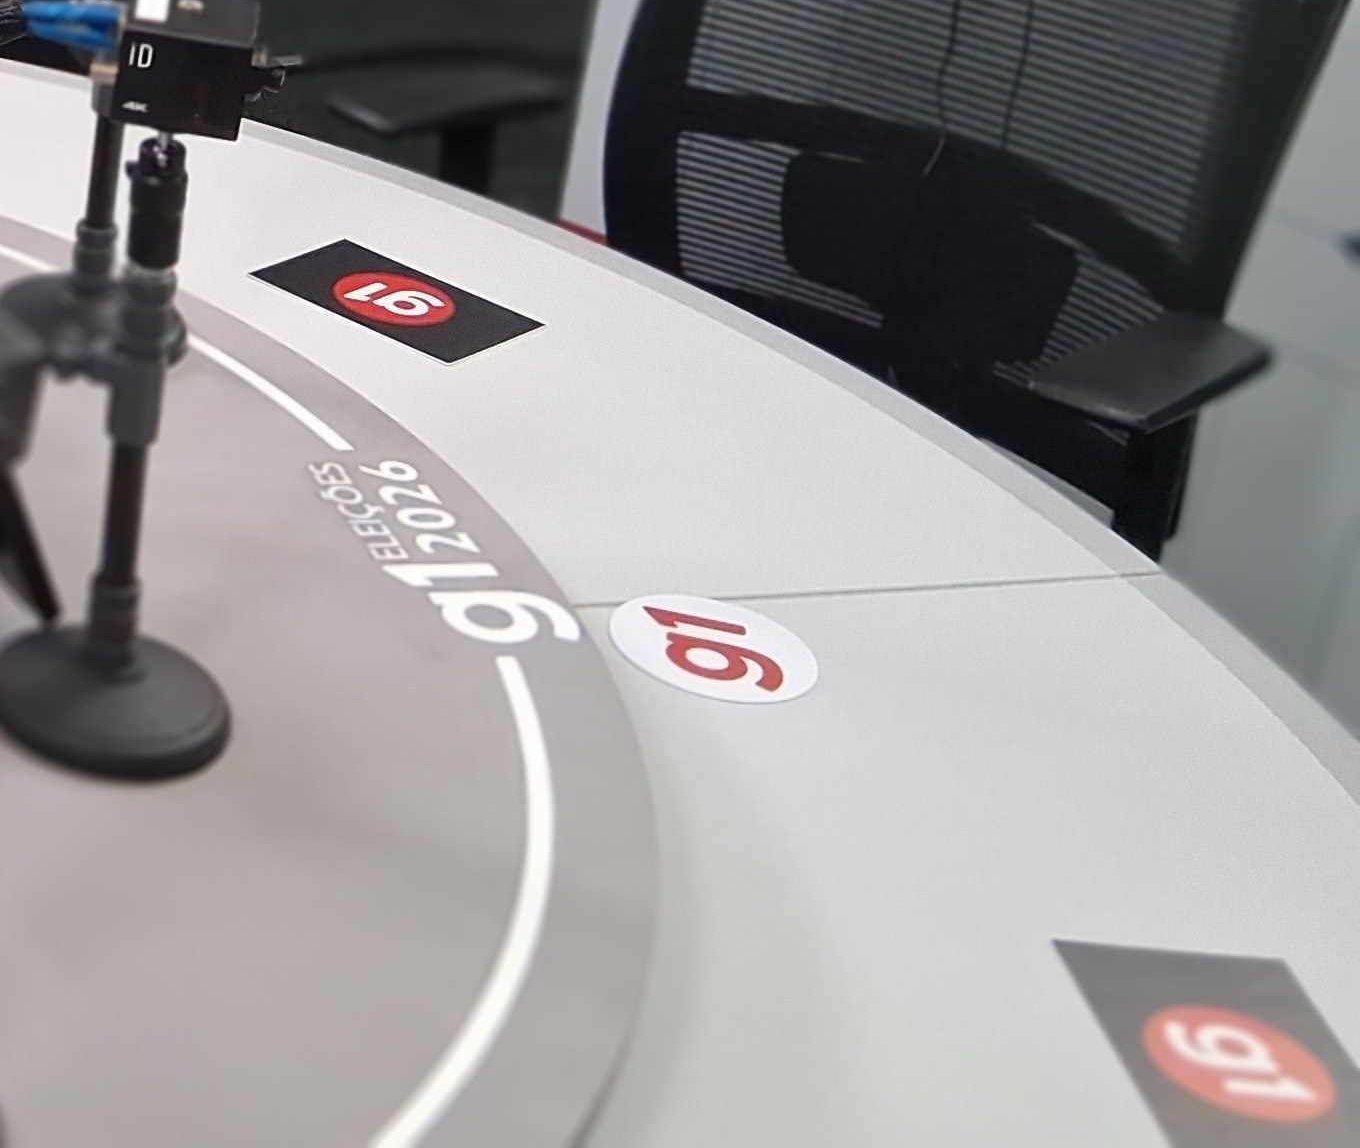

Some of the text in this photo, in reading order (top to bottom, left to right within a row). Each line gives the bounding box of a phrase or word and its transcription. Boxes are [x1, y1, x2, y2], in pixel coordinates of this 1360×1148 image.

[344, 282, 445, 317] g1
[358, 461, 480, 553] 2026
[381, 563, 580, 643] g1
[643, 606, 783, 691] g1
[1163, 1021, 1319, 1103] g1
